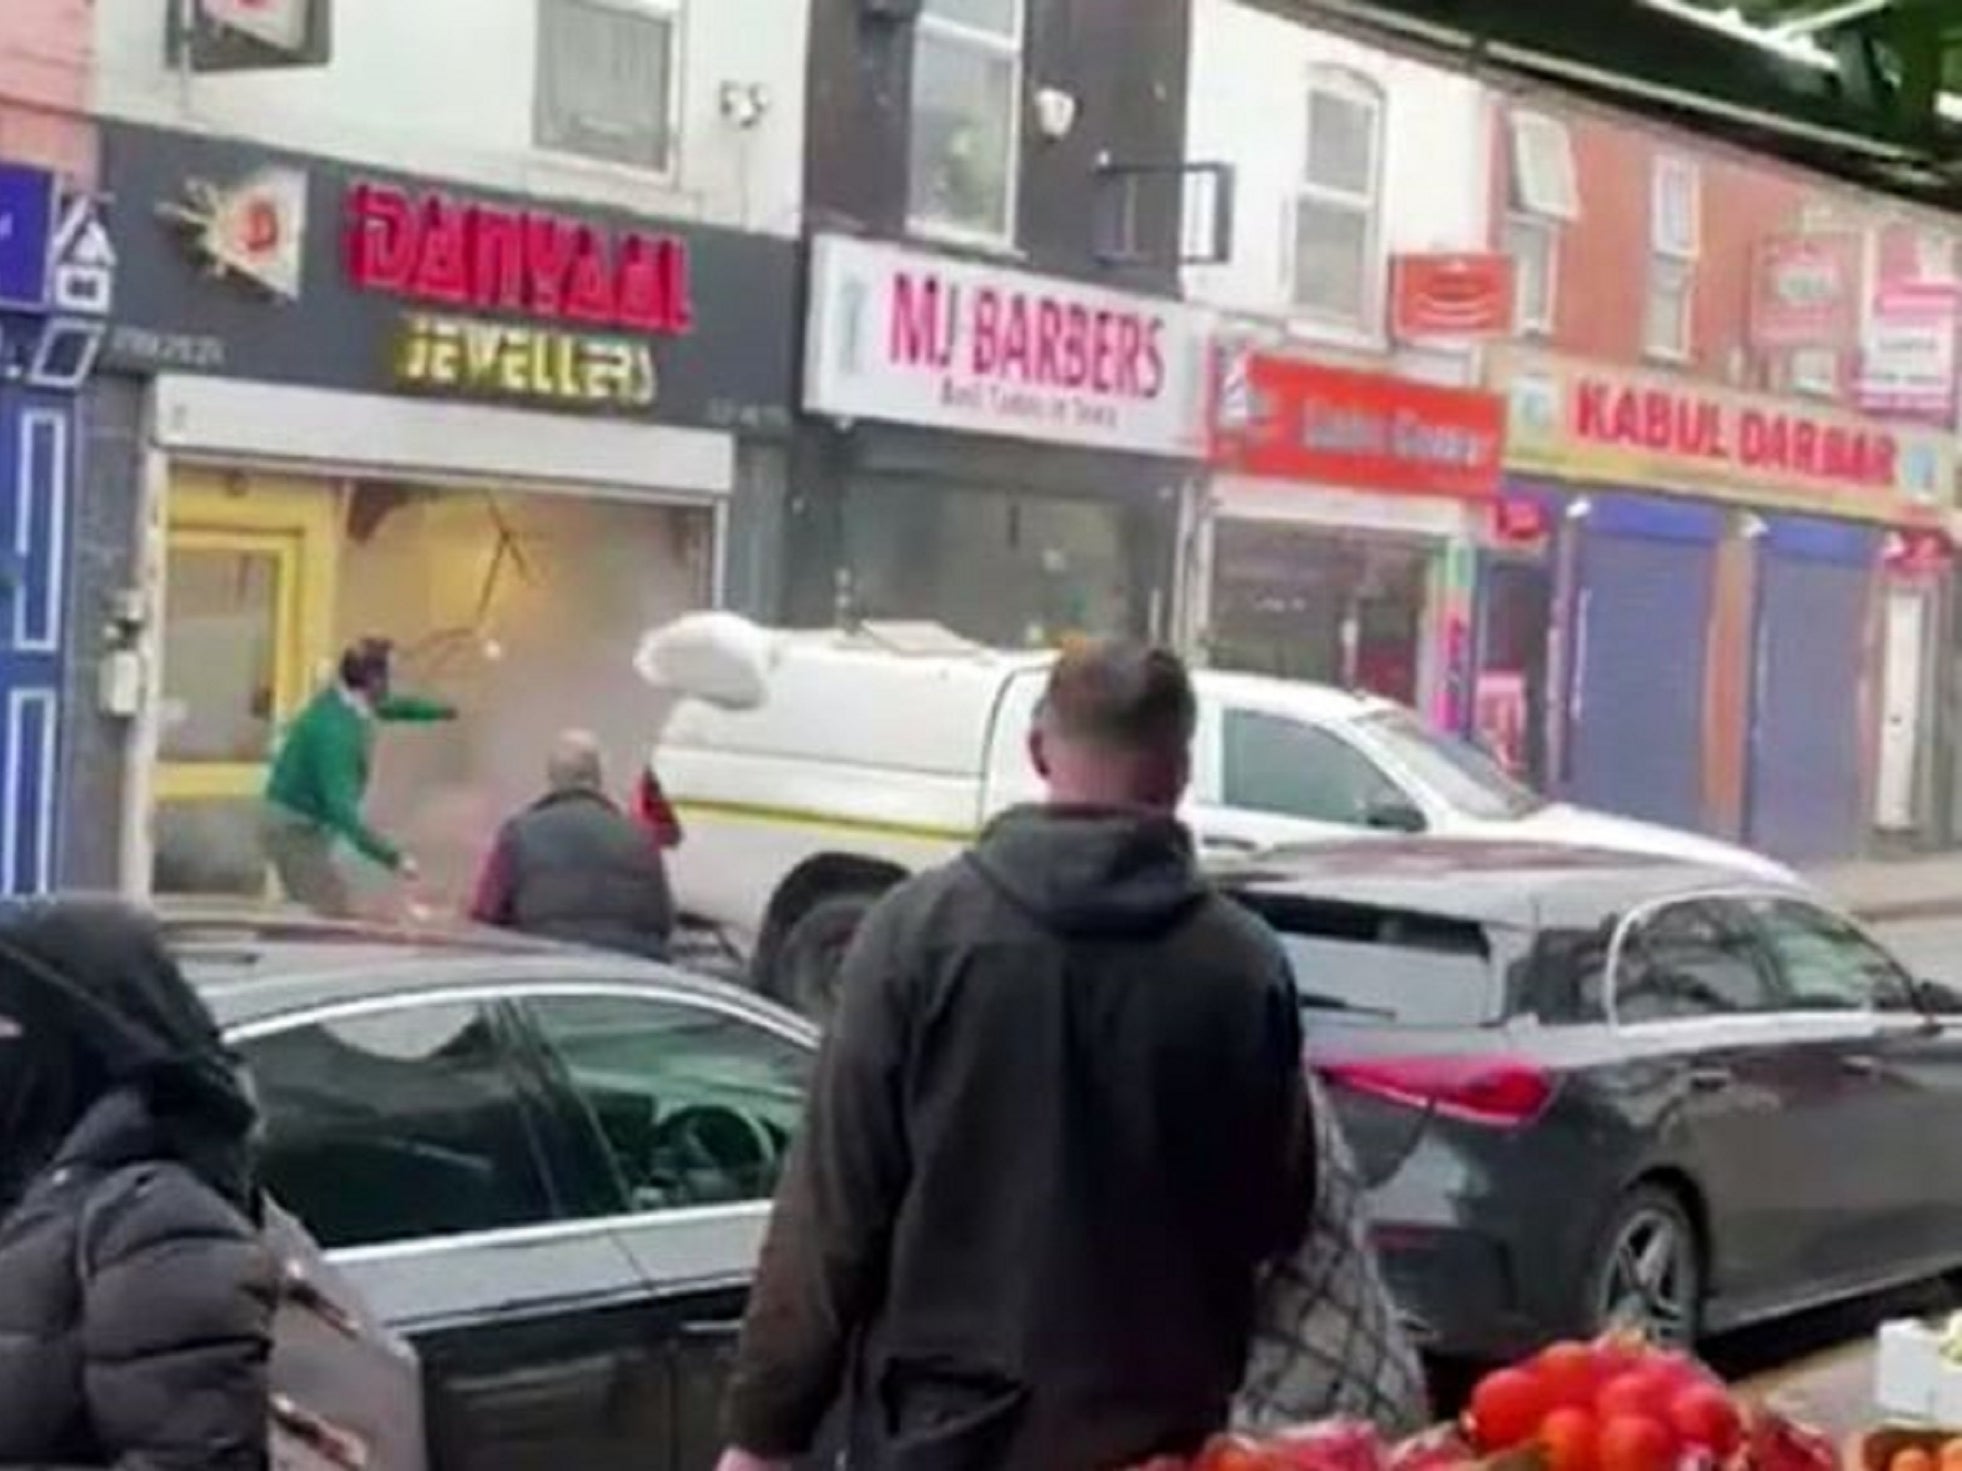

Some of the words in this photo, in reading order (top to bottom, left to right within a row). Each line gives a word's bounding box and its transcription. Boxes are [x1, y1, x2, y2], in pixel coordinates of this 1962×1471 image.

[344, 181, 691, 335] DANYAAL
[404, 317, 656, 403] JEWELLERS
[890, 273, 958, 367] MJ
[973, 289, 1165, 398] BARBERS
[1576, 378, 1727, 459] KABUL
[1738, 408, 1898, 486] DARBAR
